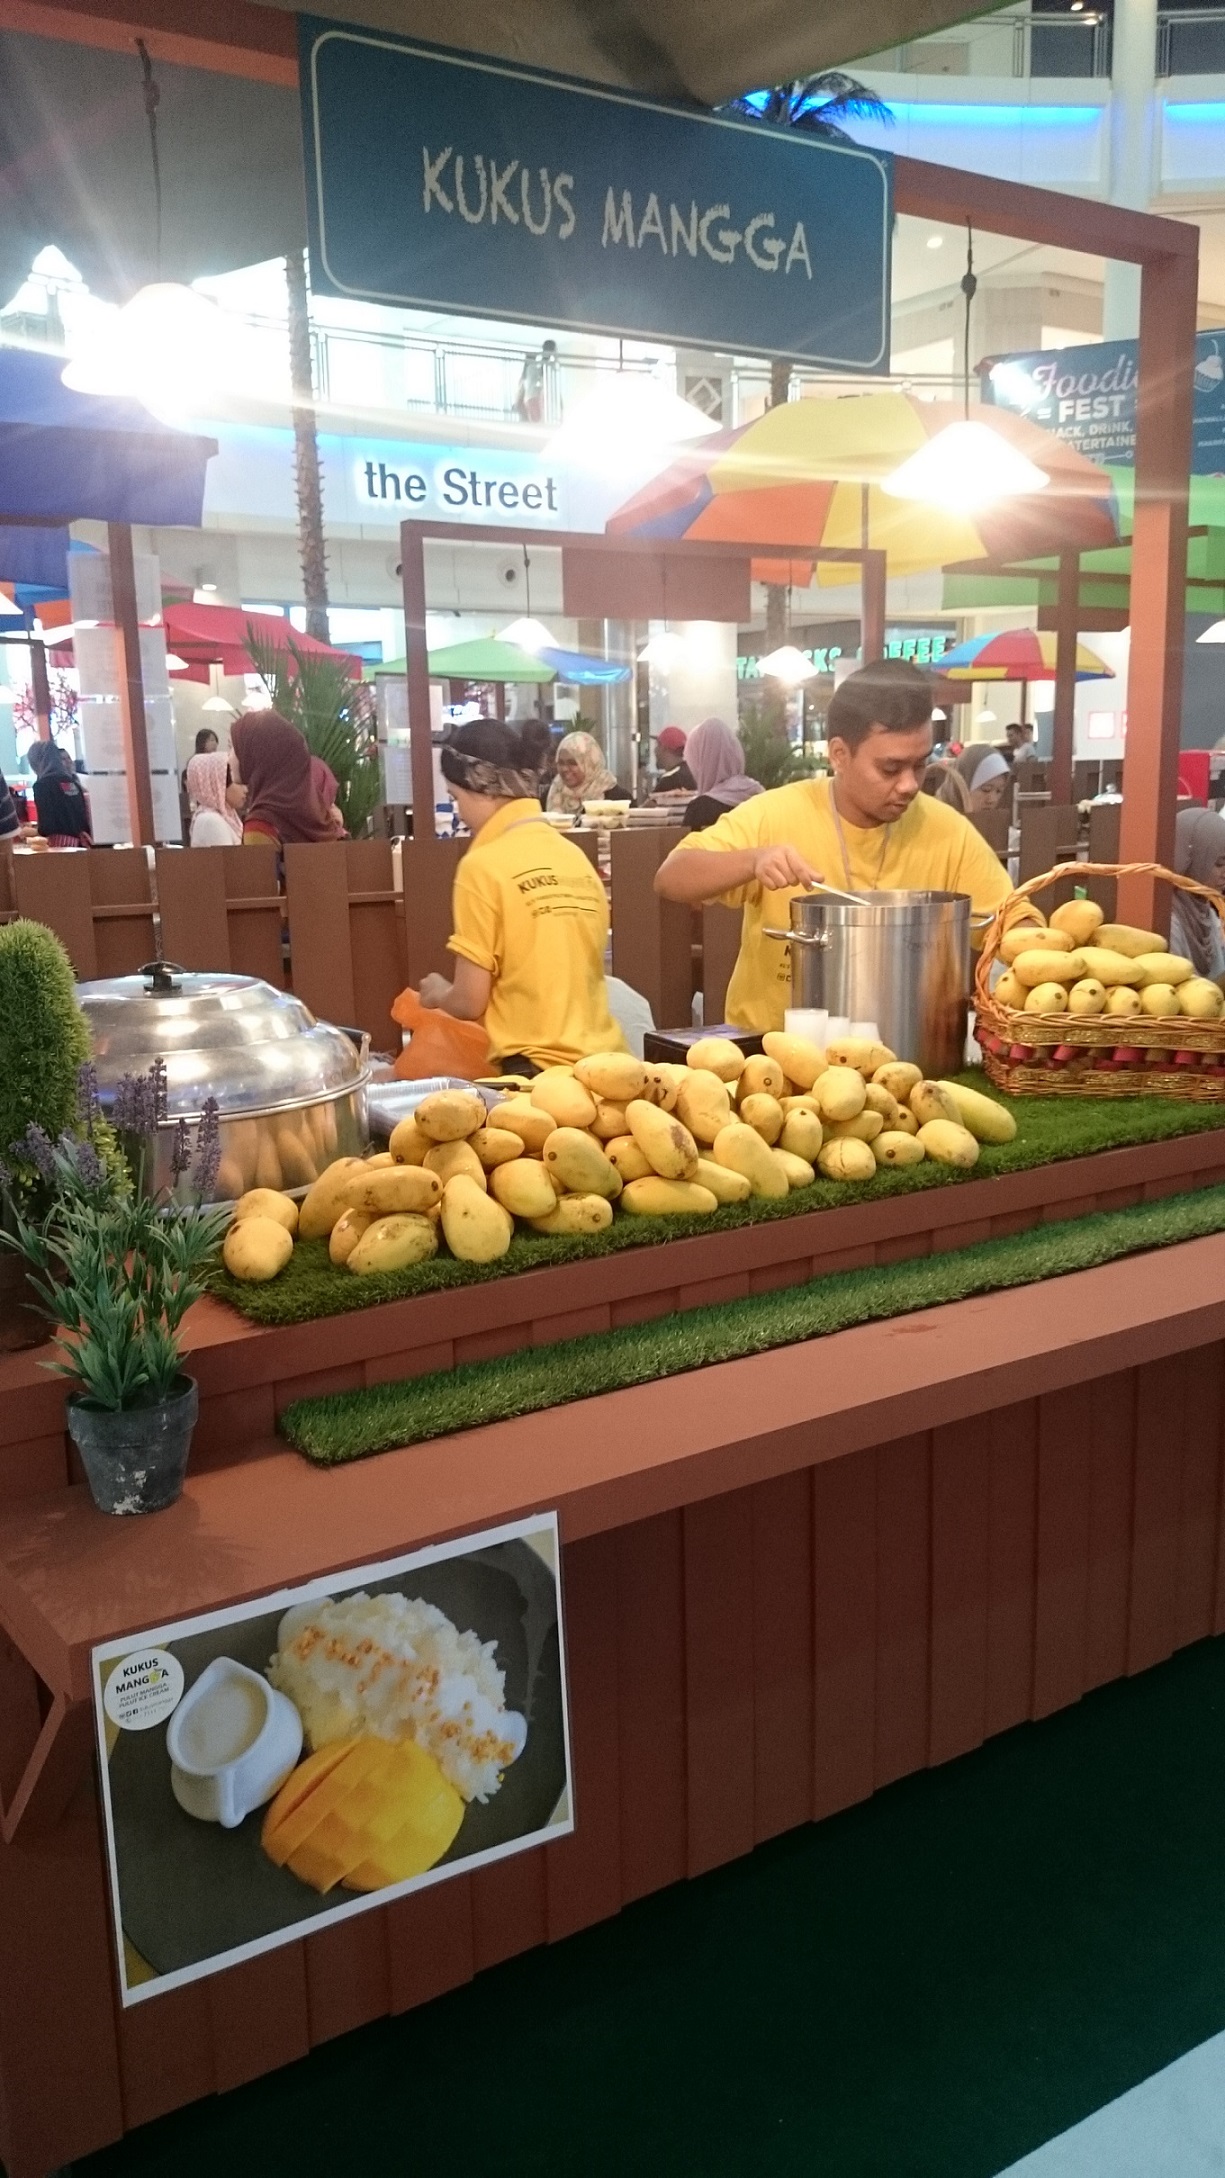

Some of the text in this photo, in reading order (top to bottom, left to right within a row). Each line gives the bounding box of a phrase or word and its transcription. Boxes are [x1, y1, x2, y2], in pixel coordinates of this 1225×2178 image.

[423, 146, 813, 280] KUKUS MANGGA
[1058, 394, 1126, 423] FEST
[364, 461, 558, 511] the Street
[856, 635, 947, 664] FFEE
[517, 874, 559, 895] KUKUS
[123, 1658, 159, 1678] KUKUS
